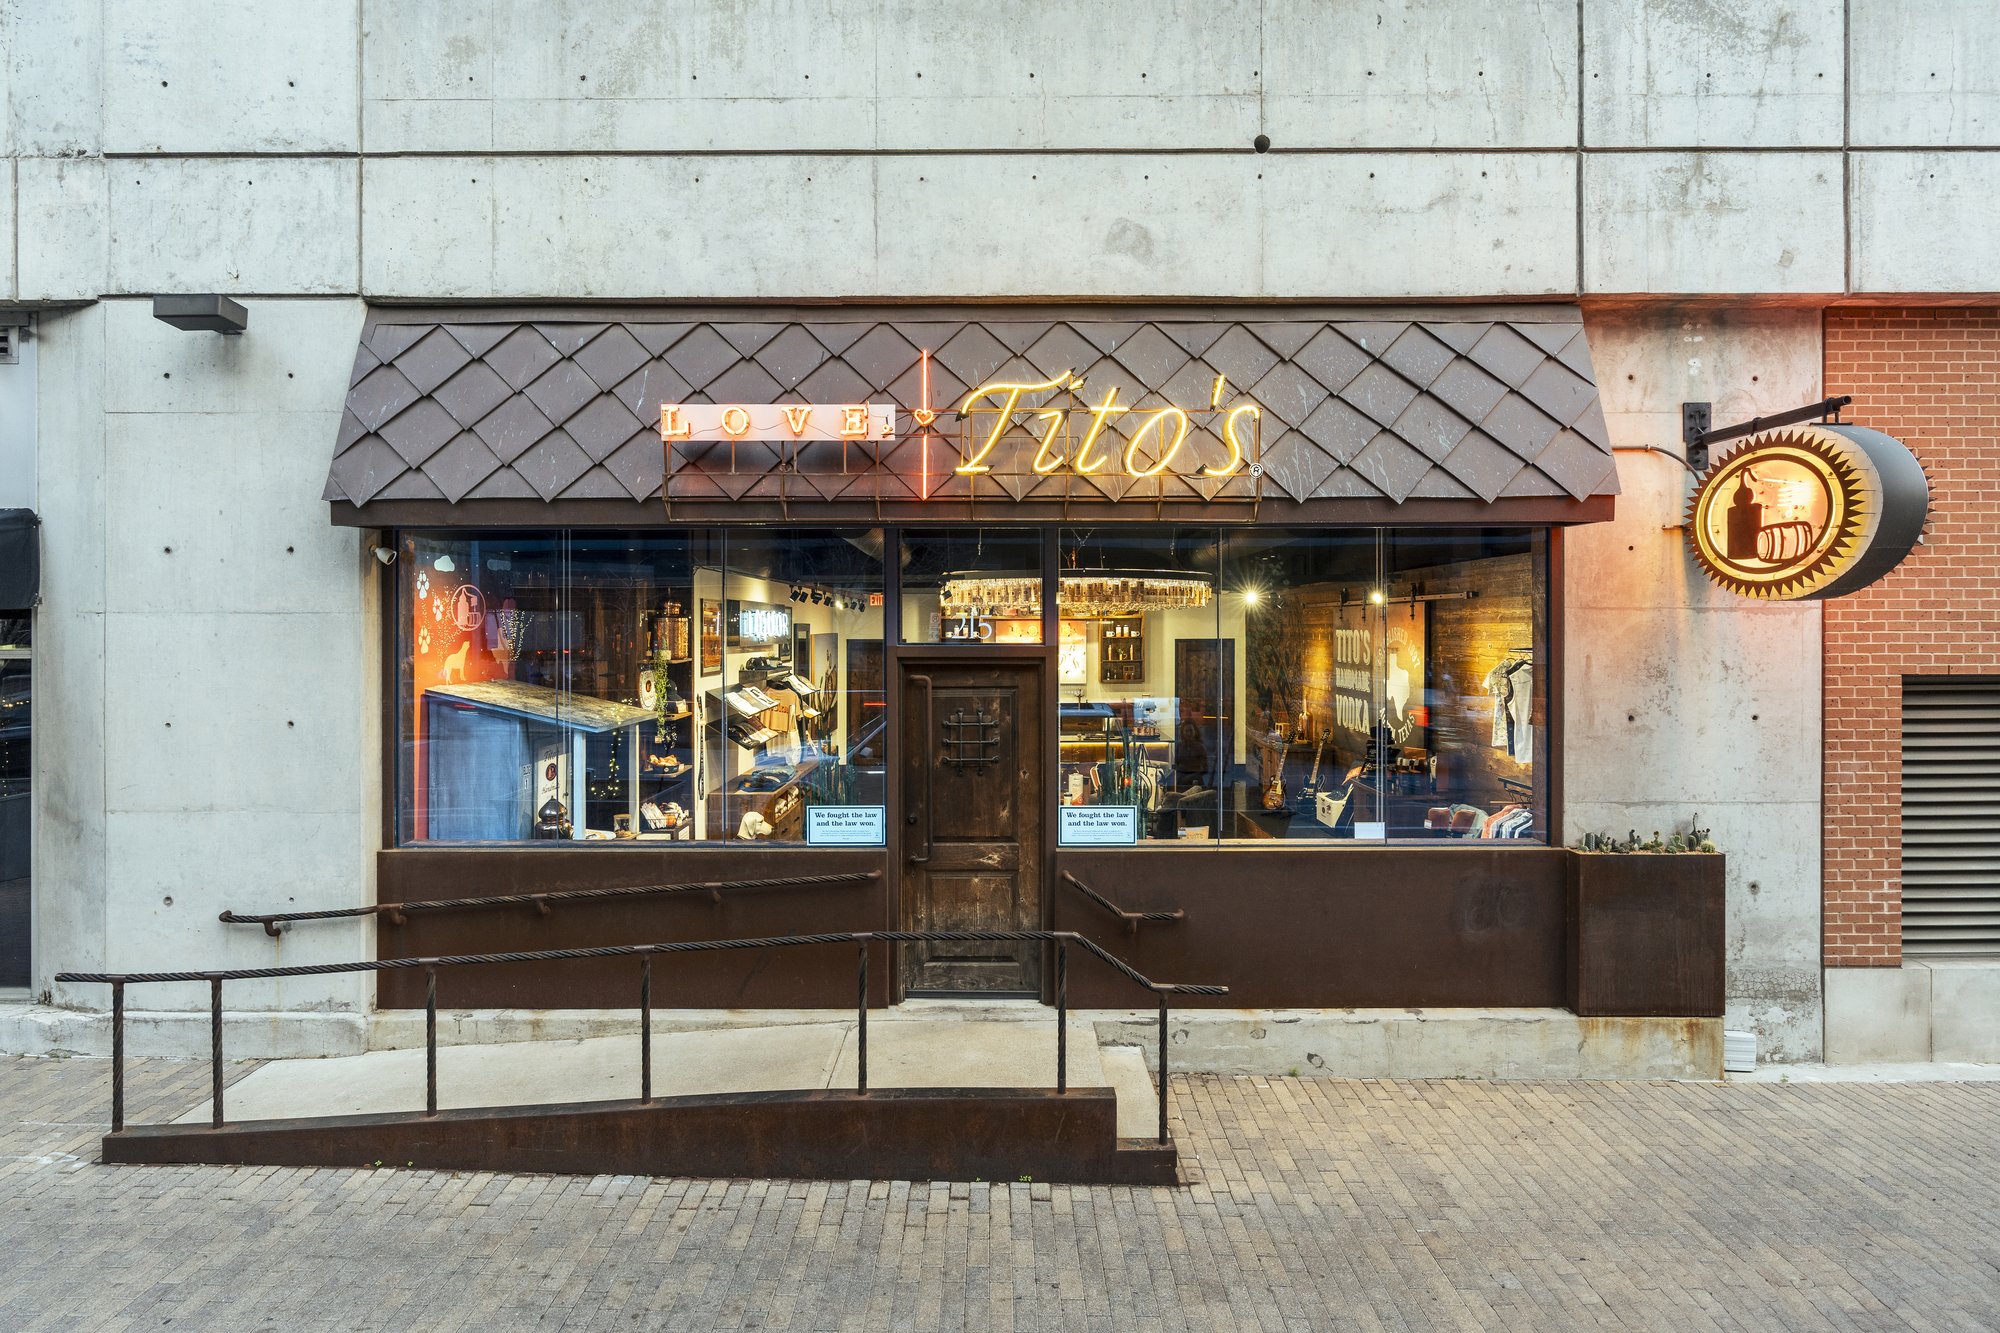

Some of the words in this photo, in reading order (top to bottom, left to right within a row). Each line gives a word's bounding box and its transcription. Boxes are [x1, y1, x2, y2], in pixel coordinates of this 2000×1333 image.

[952, 615, 992, 639] 215
[1336, 629, 1370, 666] TITO'S
[1336, 694, 1370, 735] VODKA
[1398, 712, 1414, 743] TEXAS
